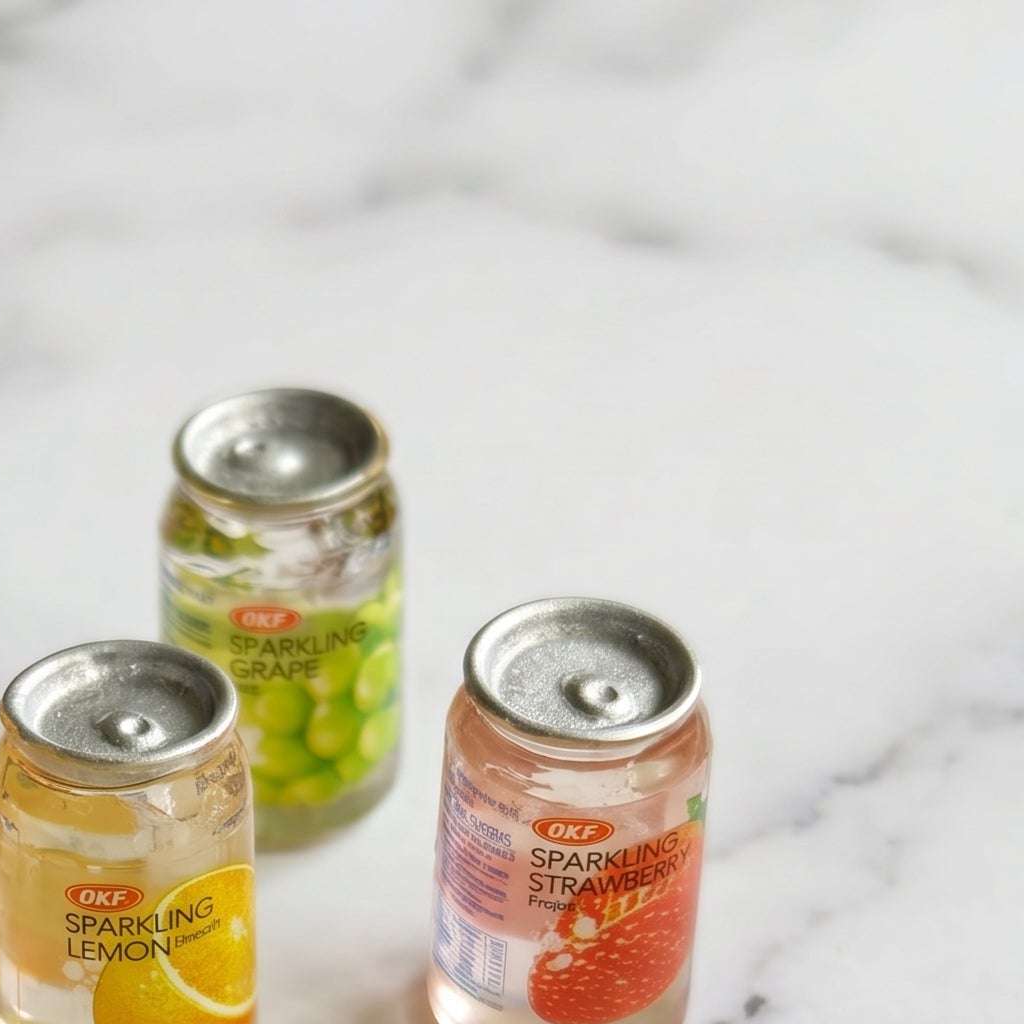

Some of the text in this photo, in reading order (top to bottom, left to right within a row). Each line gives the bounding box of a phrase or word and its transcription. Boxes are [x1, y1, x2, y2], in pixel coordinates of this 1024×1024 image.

[241, 611, 287, 628] OKF
[229, 621, 367, 658] SPARKLING
[229, 658, 321, 681] GRAPE
[547, 822, 598, 840] OKF
[530, 831, 679, 872] SPARKLING
[528, 842, 691, 897] STRAWBERRY
[79, 889, 128, 906] OKF
[65, 896, 214, 936] SPARKLING
[68, 936, 171, 962] LEMON
